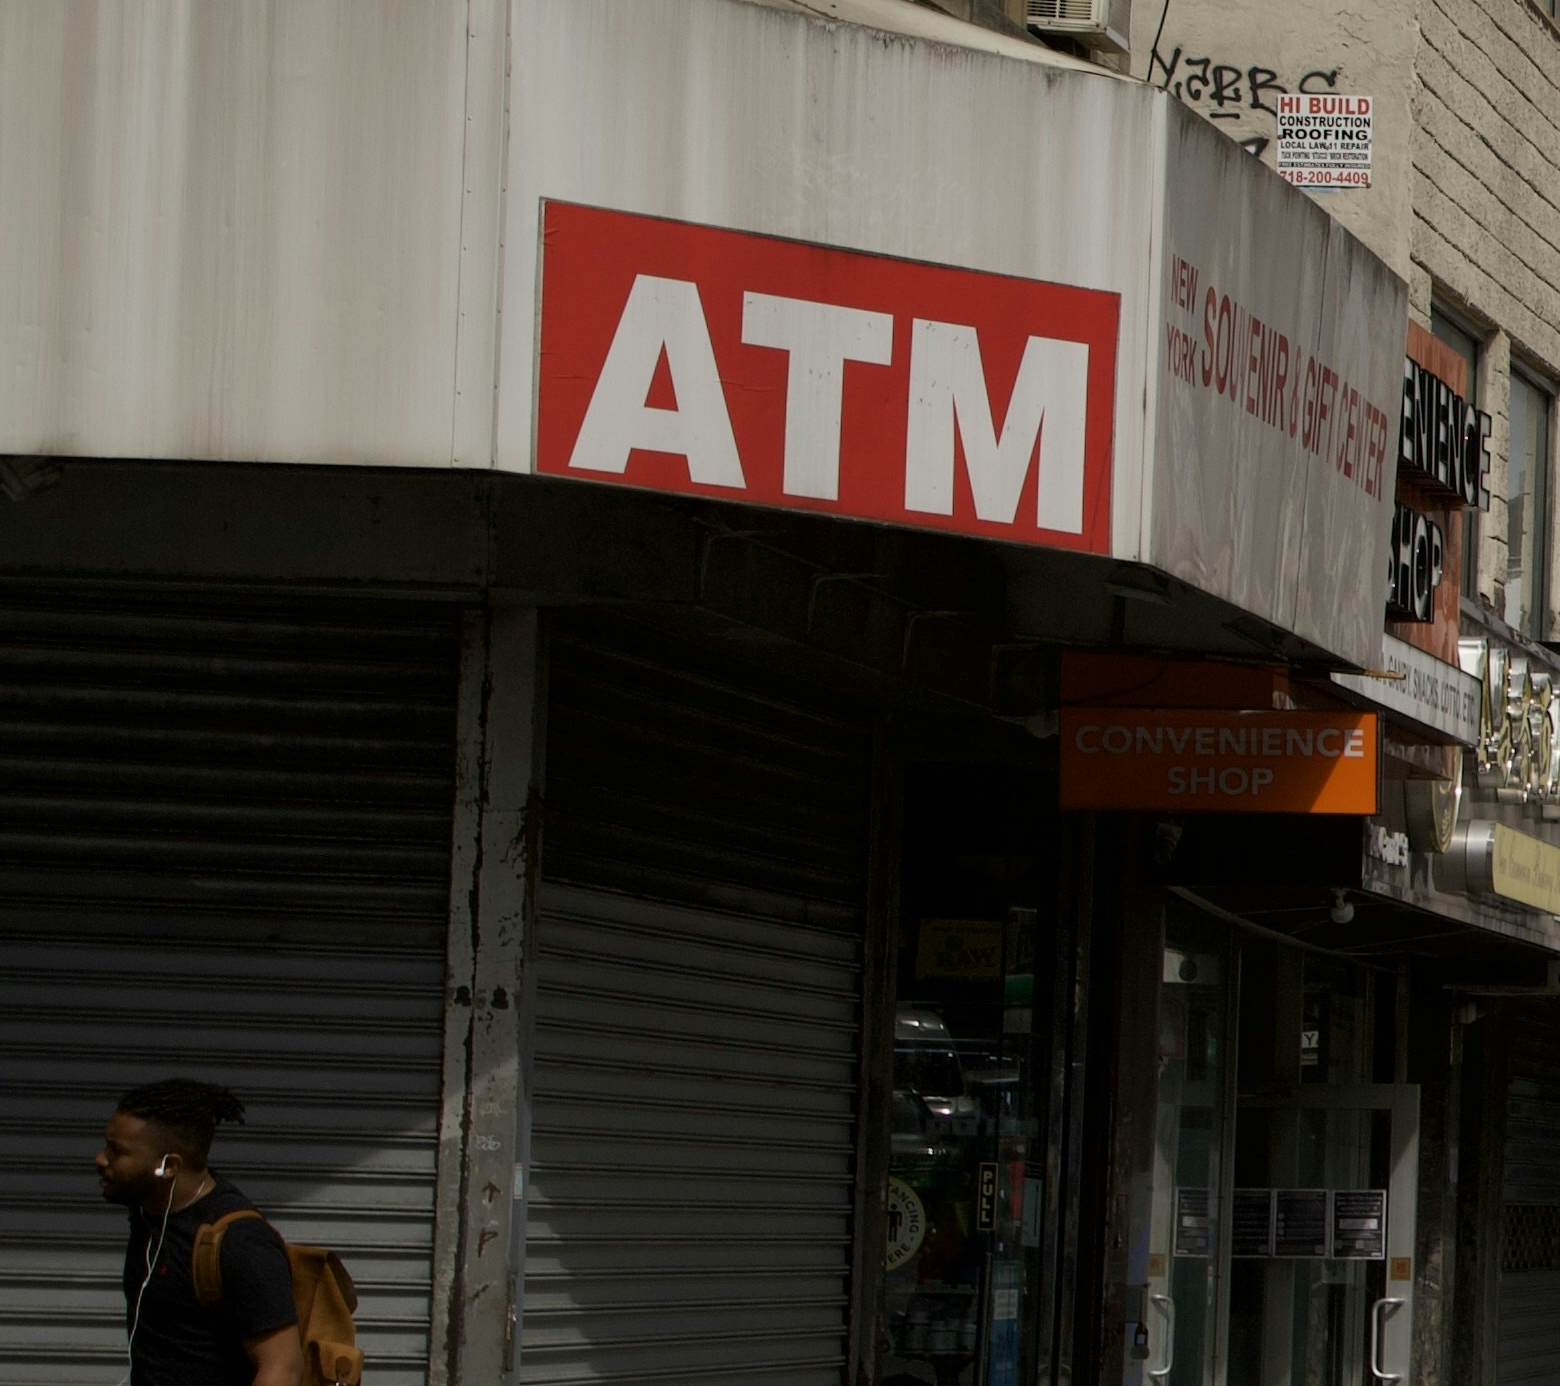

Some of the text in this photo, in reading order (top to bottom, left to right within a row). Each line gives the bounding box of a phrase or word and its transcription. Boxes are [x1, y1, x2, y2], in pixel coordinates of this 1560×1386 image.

[1279, 116, 1371, 128] CONSTRUCTION
[1280, 97, 1370, 115] HI BUILD
[1280, 141, 1306, 150] LOCAL
[1341, 143, 1370, 151] REPAIR
[1282, 128, 1369, 141] ROOFING
[1280, 170, 1369, 185] 718-200-4409
[1171, 253, 1199, 315] NEW
[1166, 321, 1197, 388] YORK
[568, 273, 1090, 535] ATM
[1201, 286, 1290, 432] SOUVENIR
[1302, 355, 1339, 463] GIFT
[1336, 381, 1388, 503] CENTER
[1402, 354, 1492, 512] ENIENCE
[1074, 725, 1366, 758] CONVENIENCE
[1166, 766, 1275, 796] SHOP
[890, 1186, 921, 1235] ANCING
[981, 1170, 995, 1224] PULL
